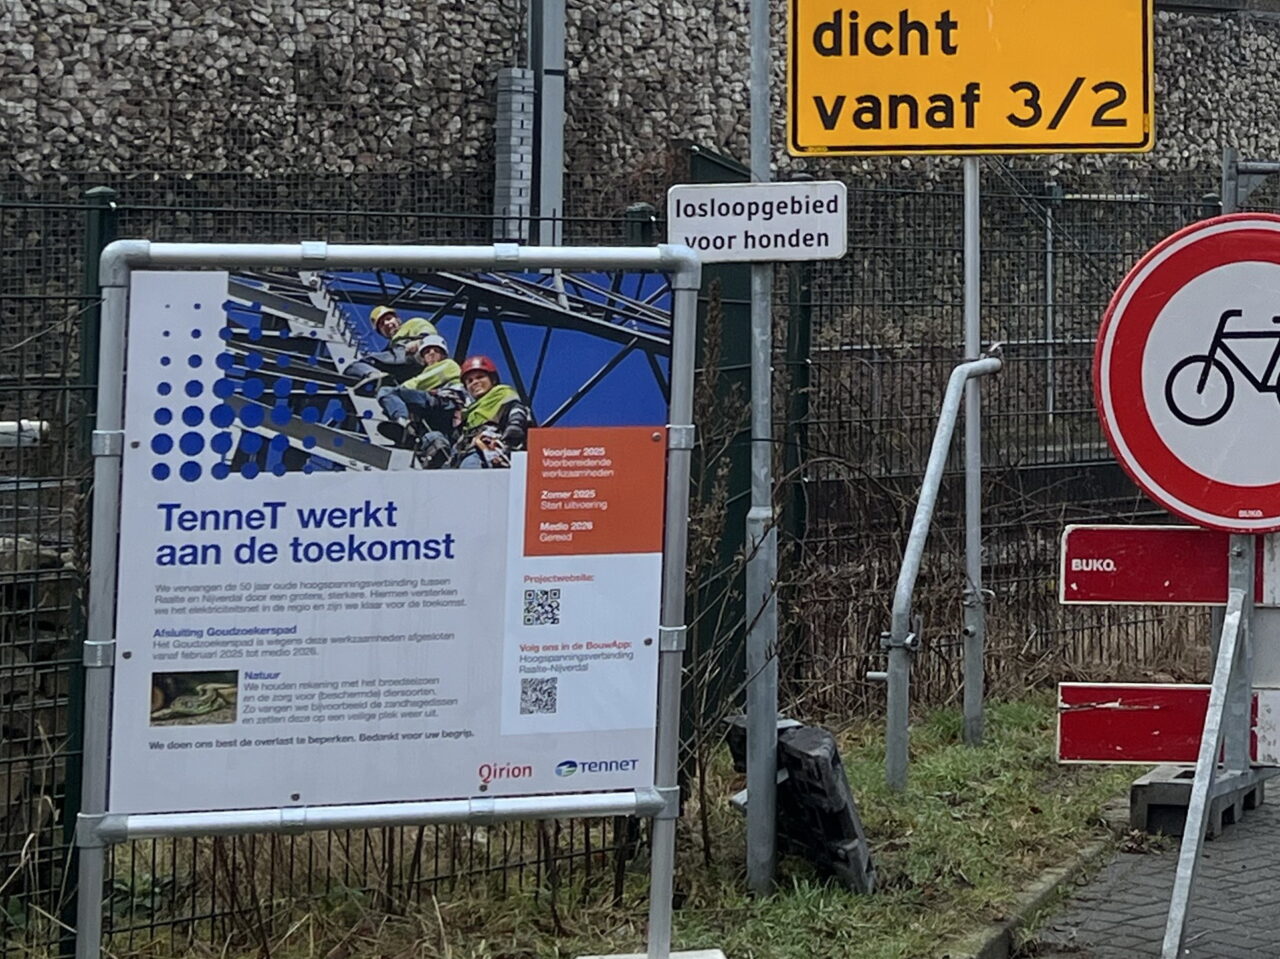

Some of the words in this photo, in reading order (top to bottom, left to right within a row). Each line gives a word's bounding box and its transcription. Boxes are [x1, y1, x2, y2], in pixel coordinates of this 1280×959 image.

[812, 8, 959, 57] dicht
[813, 82, 981, 131] vanaf
[1006, 77, 1128, 130] 3/2
[675, 195, 839, 221] losloopgebied
[685, 232, 736, 250] voor
[744, 228, 830, 250] honden
[542, 447, 581, 457] Voorjaar
[541, 490, 572, 499] Zomer
[541, 501, 562, 510] Start
[157, 501, 287, 532] TenneT
[296, 500, 398, 529] werkt
[540, 522, 569, 531] Medio
[155, 543, 222, 567] aan
[234, 536, 279, 565] de
[289, 533, 456, 564] toekomst
[1071, 558, 1117, 571] BUKO.
[225, 582, 237, 591] de
[254, 582, 271, 592] jaar
[273, 581, 297, 590] oude
[245, 593, 267, 602] door
[171, 606, 186, 615] het
[272, 604, 285, 612] de
[385, 601, 406, 609] voor
[408, 600, 420, 608] de
[152, 628, 204, 638] Afsluiting
[206, 625, 297, 636] Goudzoekerspad
[153, 640, 170, 649] Het
[561, 642, 569, 651] in
[572, 641, 583, 650] de
[152, 651, 179, 661] vanaf
[219, 649, 244, 658] 2025
[246, 649, 259, 658] tot
[261, 647, 291, 657] medio
[244, 671, 281, 680] Natuur
[261, 681, 297, 690] houden
[341, 679, 359, 688] met
[361, 678, 376, 687] het
[257, 693, 269, 702] de
[272, 694, 292, 703] zorg
[243, 705, 256, 714] Zo
[312, 714, 325, 724] op
[149, 742, 165, 750] We
[167, 740, 193, 750] doen
[215, 739, 238, 748] best
[240, 739, 252, 747] de
[255, 737, 294, 746] overlast
[296, 737, 307, 745] te
[359, 732, 399, 742] Bedankt
[401, 732, 422, 740] voor
[425, 731, 440, 739] uw
[478, 762, 533, 784] Qirion
